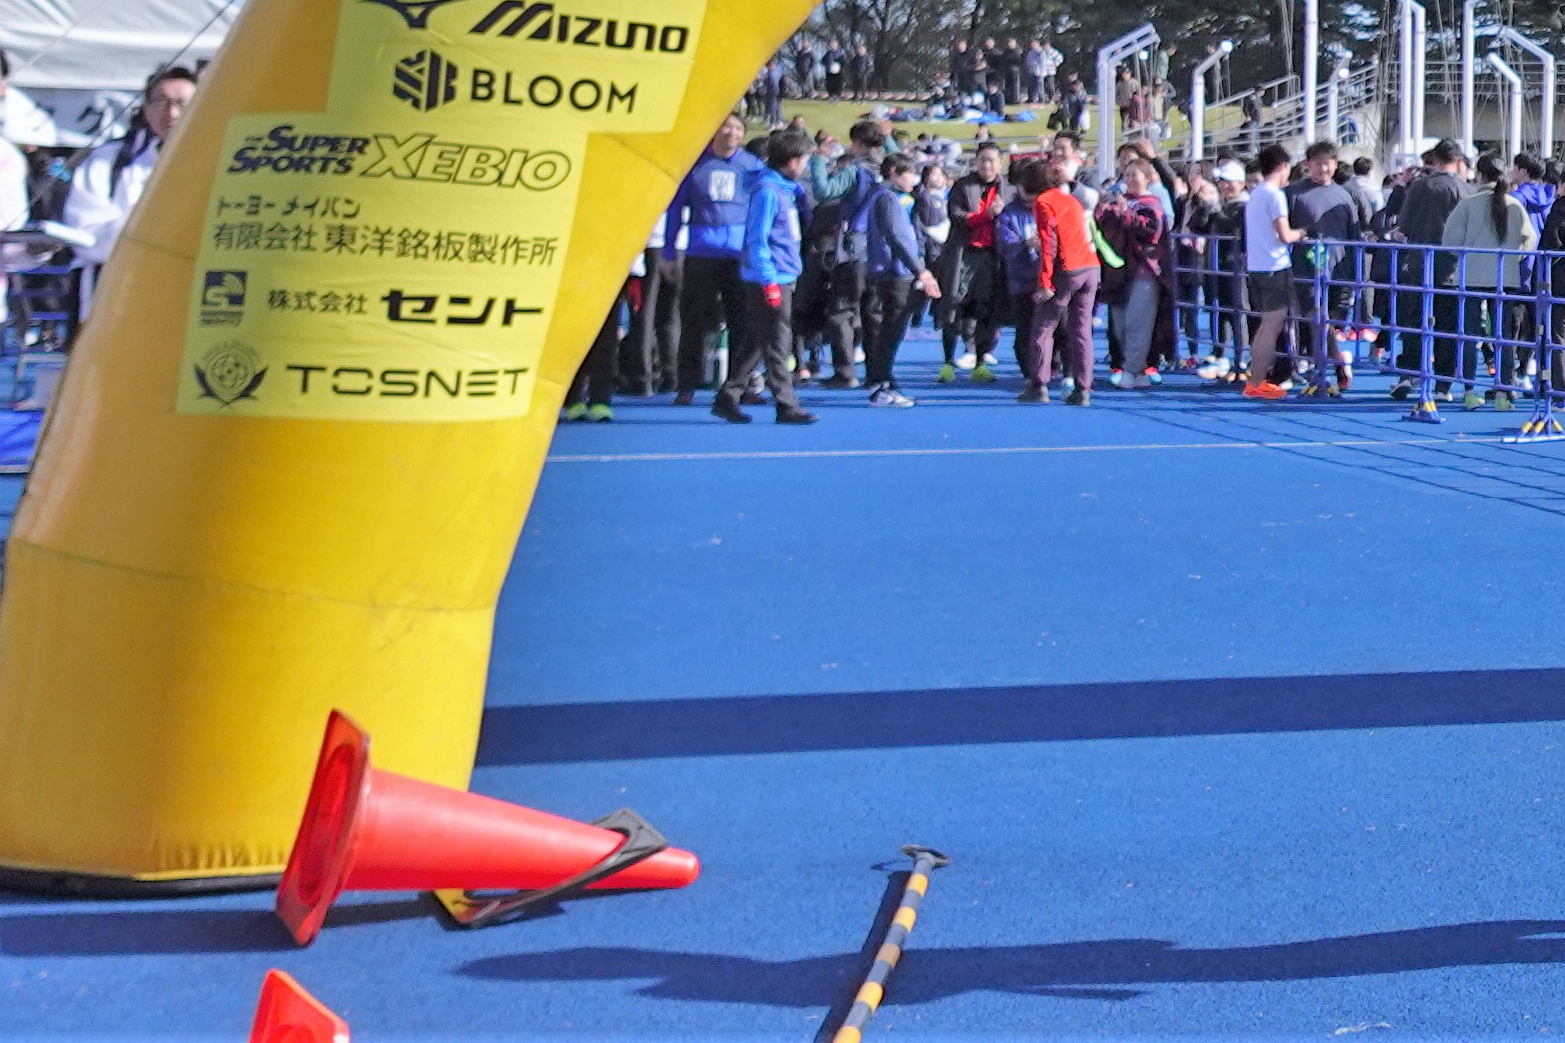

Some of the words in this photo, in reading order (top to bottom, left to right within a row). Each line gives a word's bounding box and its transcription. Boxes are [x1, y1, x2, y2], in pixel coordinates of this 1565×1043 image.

[471, 68, 639, 114] BLOOM
[360, 131, 572, 192] XEBIO
[213, 221, 318, 253] 有限会社
[266, 288, 369, 316] 株式会社
[379, 287, 546, 328] セント
[286, 363, 529, 400] TOSNET
